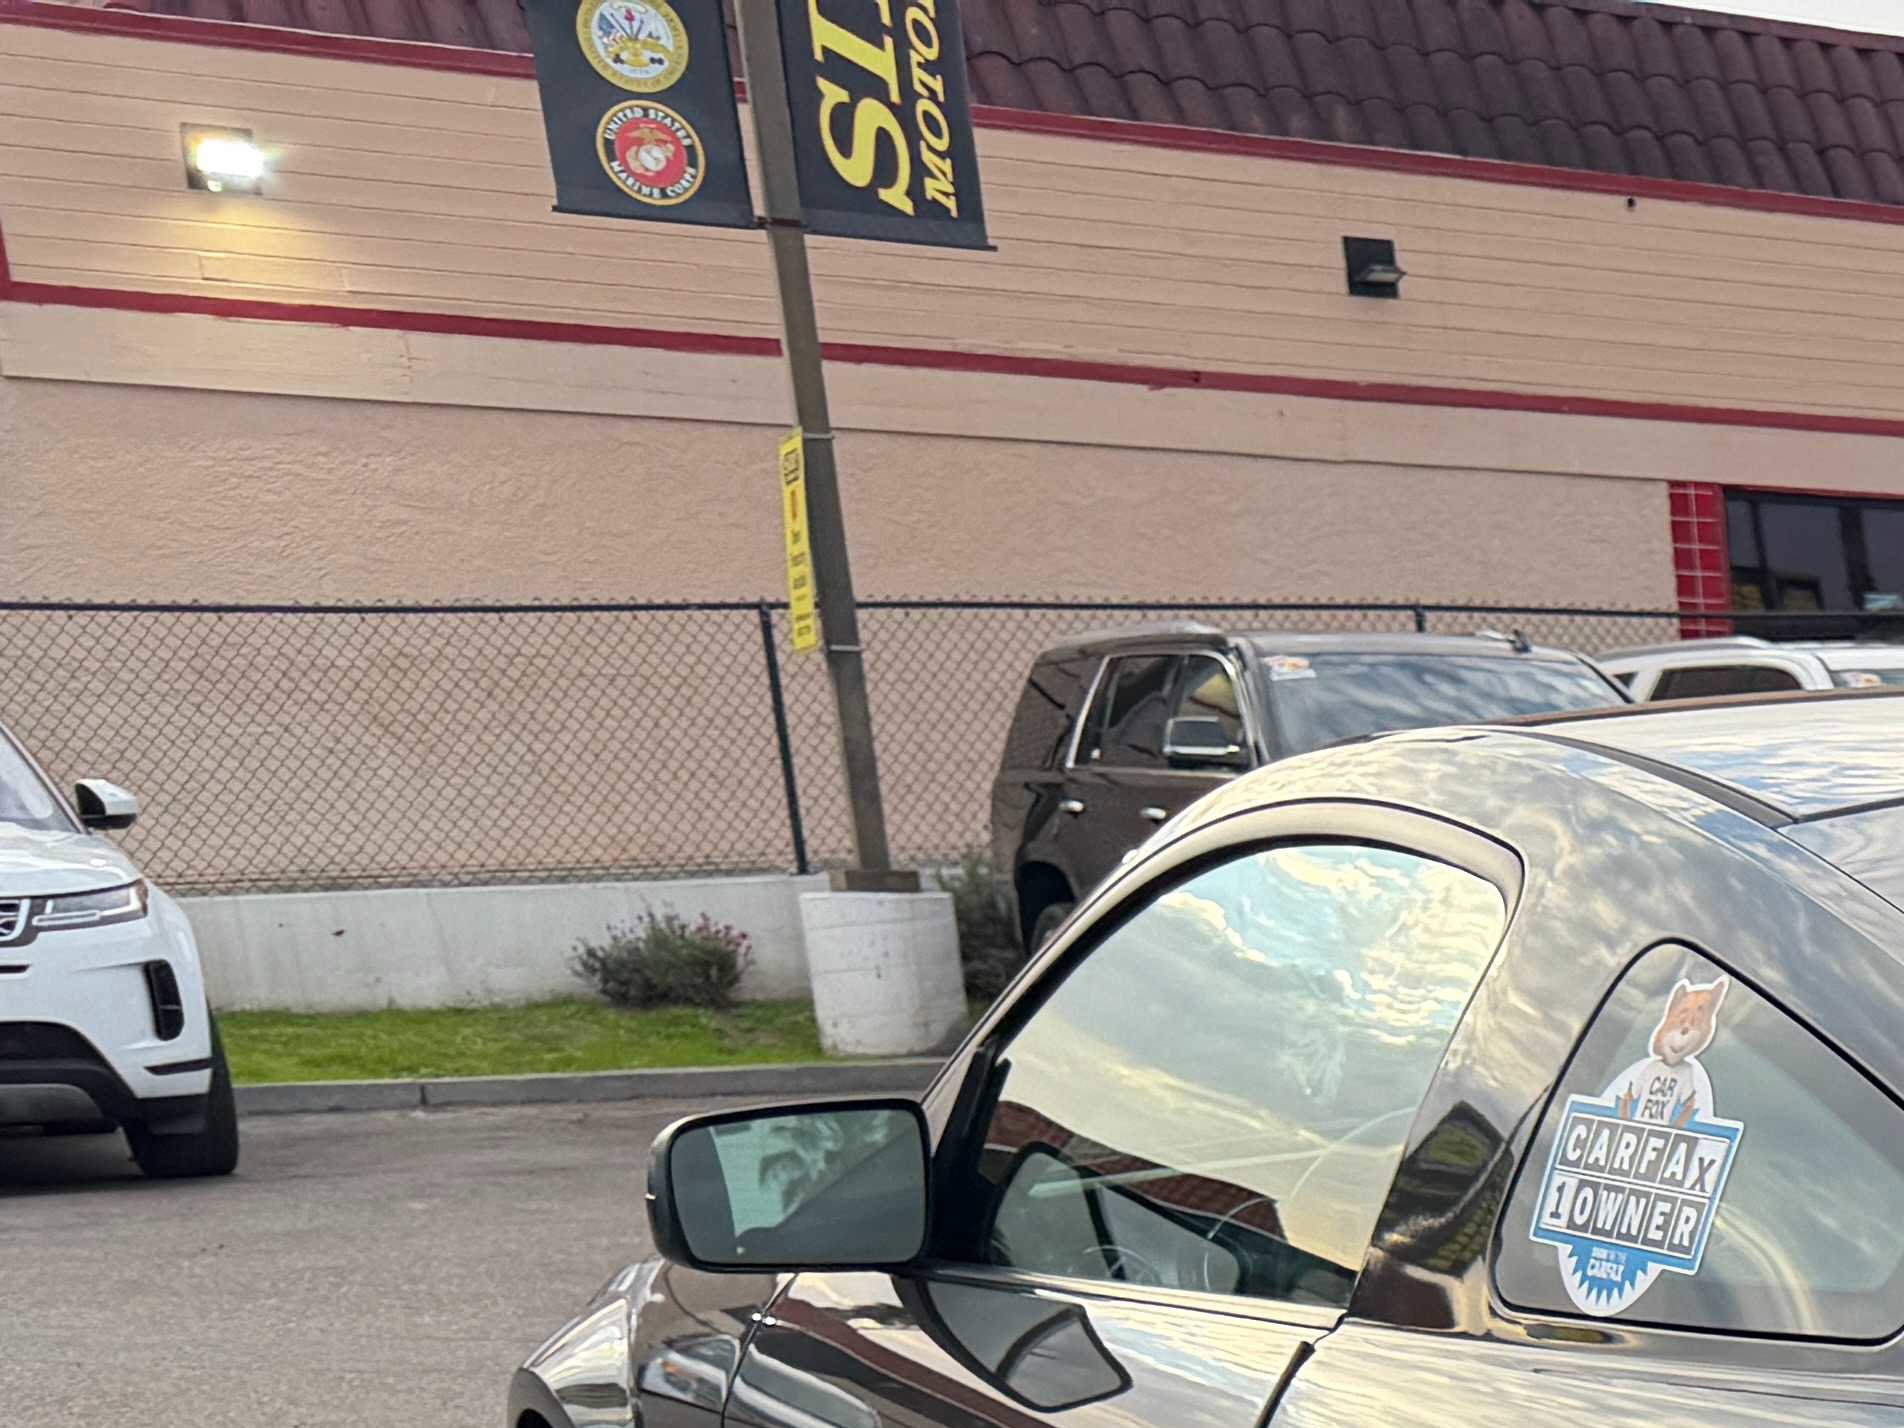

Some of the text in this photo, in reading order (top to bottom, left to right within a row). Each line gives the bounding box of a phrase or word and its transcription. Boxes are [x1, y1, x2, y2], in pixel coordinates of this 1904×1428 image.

[604, 107, 693, 146] UNITED STATES
[808, 0, 915, 217] SI
[905, 0, 958, 219] MOTO
[610, 160, 697, 199] MARINE CORPS
[1641, 1098, 1670, 1119] FOX
[1649, 1076, 1678, 1098] CAR
[1566, 1124, 1718, 1193] CARFAX
[1573, 1186, 1699, 1247] OWNER
